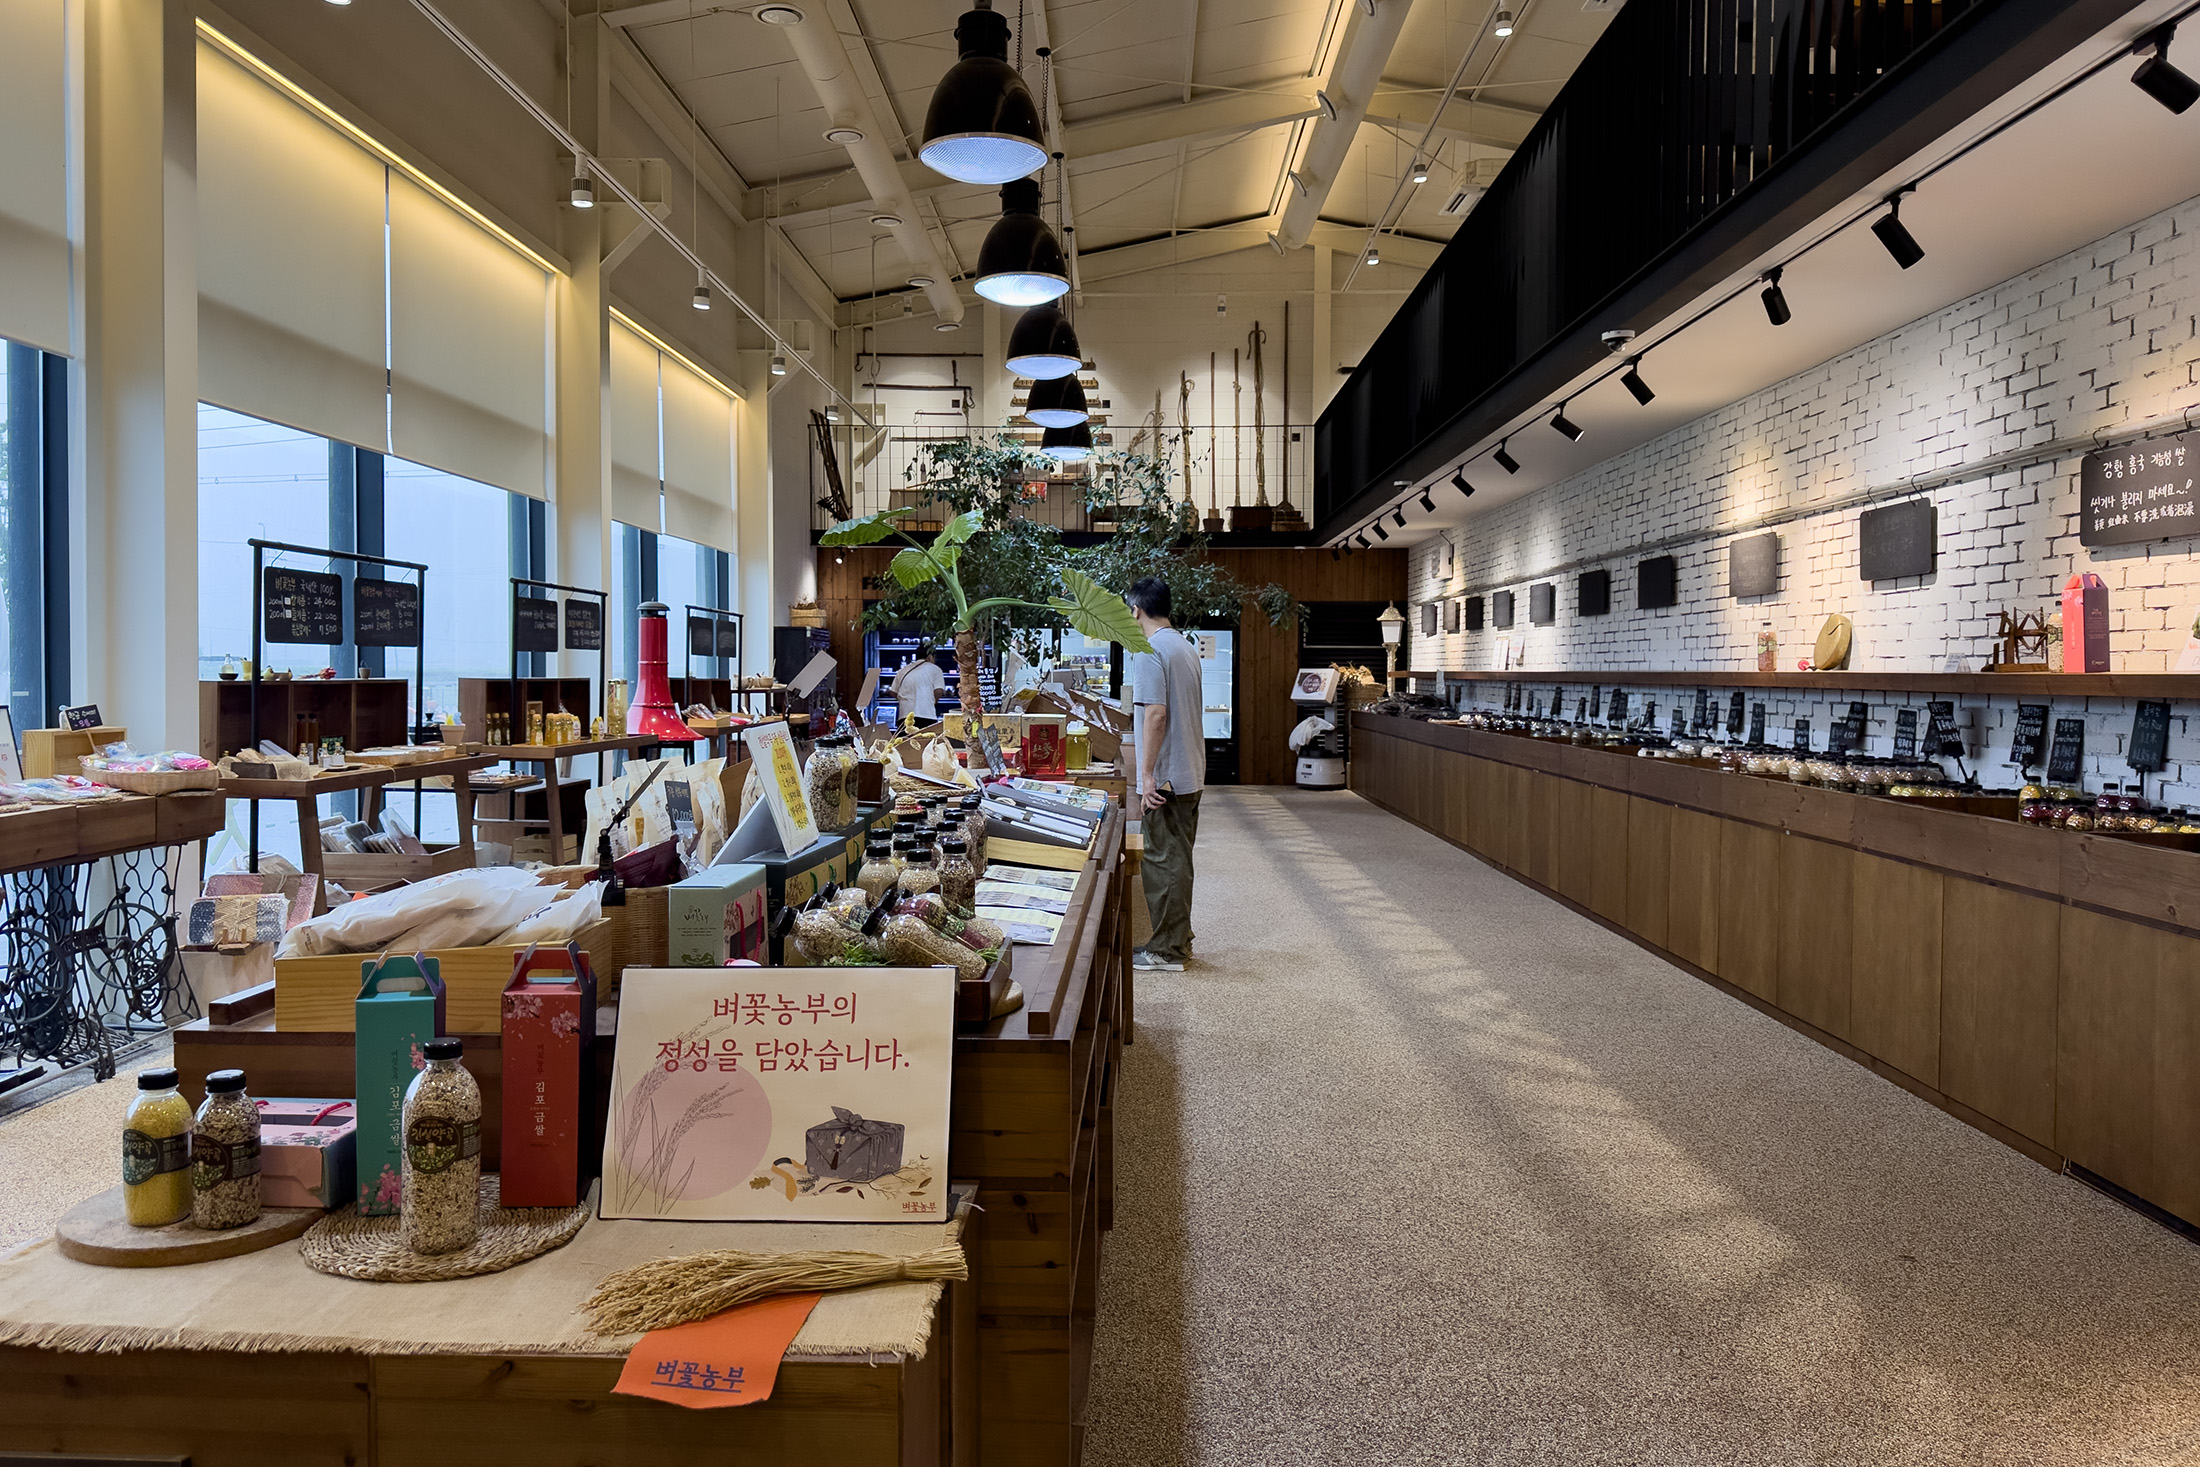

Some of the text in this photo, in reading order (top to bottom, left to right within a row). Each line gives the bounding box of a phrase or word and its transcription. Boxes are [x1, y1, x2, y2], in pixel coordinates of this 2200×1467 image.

[2103, 446, 2186, 479] 강황 홍국 기능성 쌀
[2090, 495, 2115, 514] 씻거나
[2120, 491, 2143, 511] 불리지
[711, 991, 857, 1026] 벼꽃농부의
[655, 1038, 911, 1073] 정성을 담았습니다.
[534, 1081, 546, 1137] 김포금쌀
[901, 1201, 937, 1213] 벼꽃농부
[654, 1359, 746, 1390] 벼꽃농부
